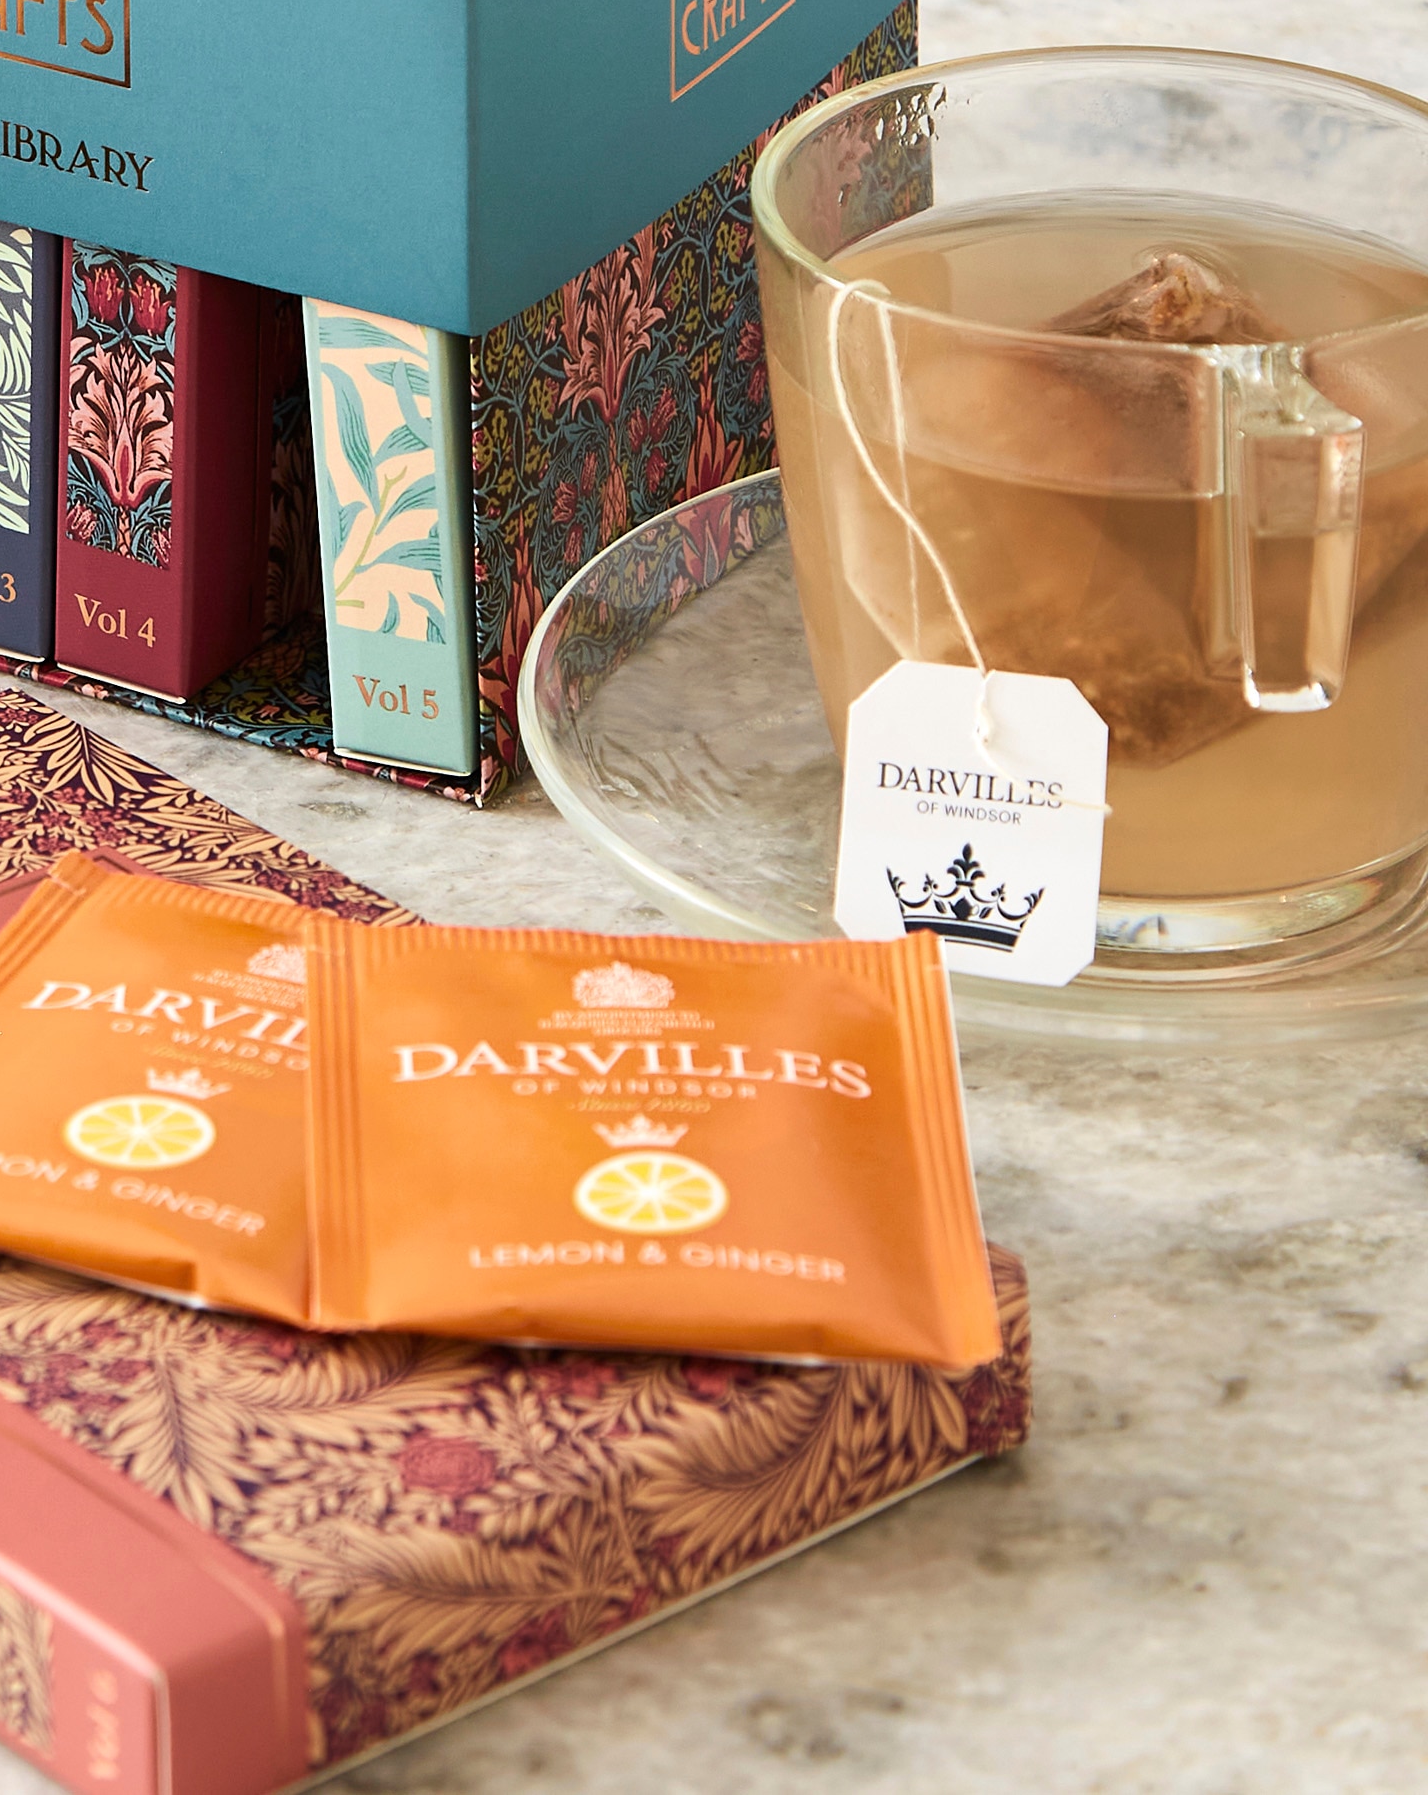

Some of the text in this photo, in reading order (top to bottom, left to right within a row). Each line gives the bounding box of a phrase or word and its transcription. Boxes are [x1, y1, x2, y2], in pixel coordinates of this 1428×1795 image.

[74, 593, 157, 648] Vol 4
[352, 674, 440, 720] Vol 5
[877, 762, 1063, 809] DARVILLES
[917, 801, 1021, 825] OF WINDSOR
[111, 1017, 156, 1037] OF
[392, 1040, 872, 1099] DARVILLES
[512, 1078, 758, 1100] OF WINDSOR
[72, 1168, 100, 1190] &
[110, 1176, 266, 1237] GINGER
[468, 1240, 847, 1286] LEMON & GINGER
